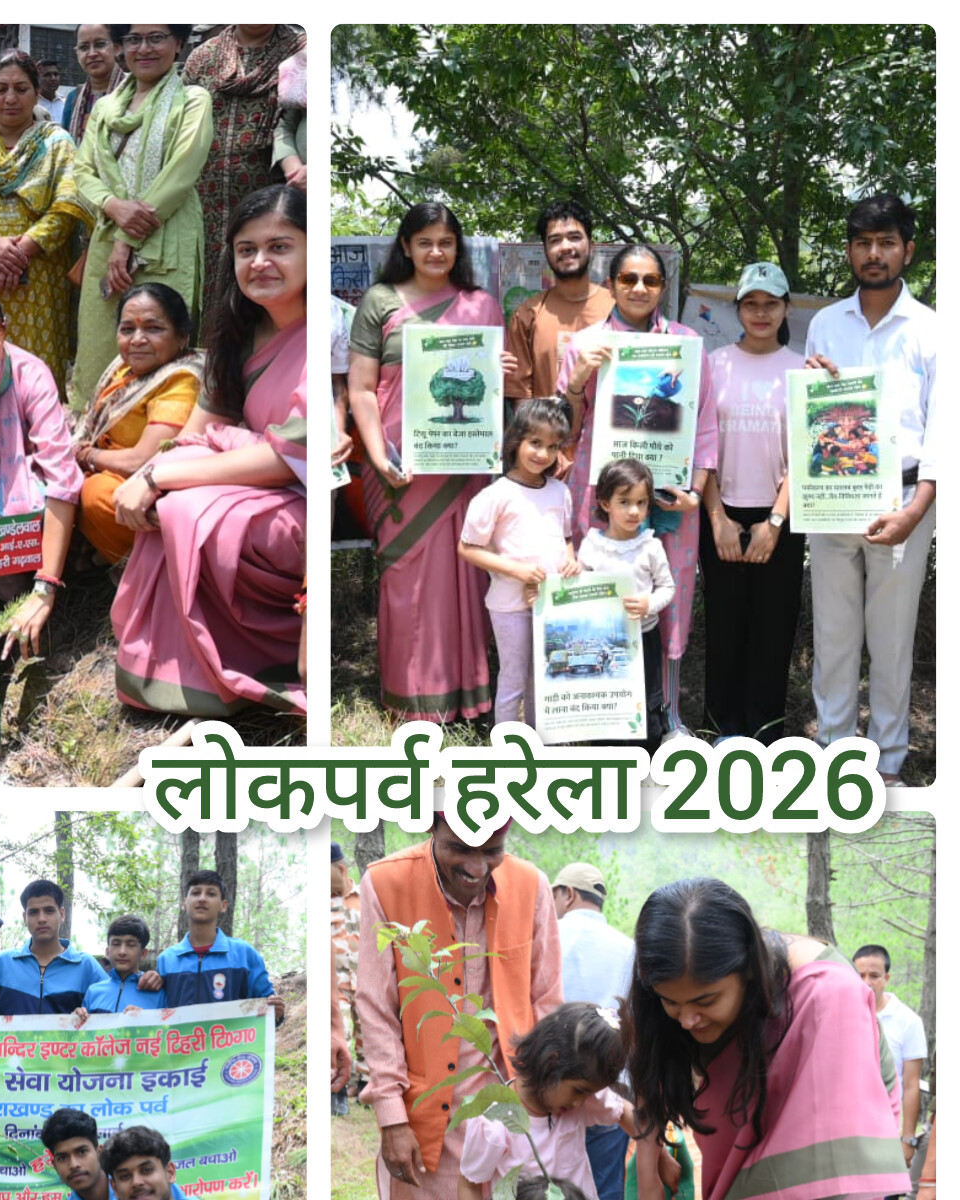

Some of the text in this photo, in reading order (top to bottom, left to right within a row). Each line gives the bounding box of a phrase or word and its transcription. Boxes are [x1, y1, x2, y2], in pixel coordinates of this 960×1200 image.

[39, 1041, 79, 1060] इण्टर
[80, 1034, 132, 1057] कॉलेज
[135, 1031, 162, 1057] नई
[166, 1026, 207, 1055] टिहरी
[4, 1066, 51, 1092] सेवा
[57, 1066, 134, 1093] योजना
[140, 1058, 209, 1092] इकाई
[90, 1097, 134, 1118] लोक
[140, 1094, 169, 1114] पर्व
[199, 1148, 238, 1166] बचाओ
